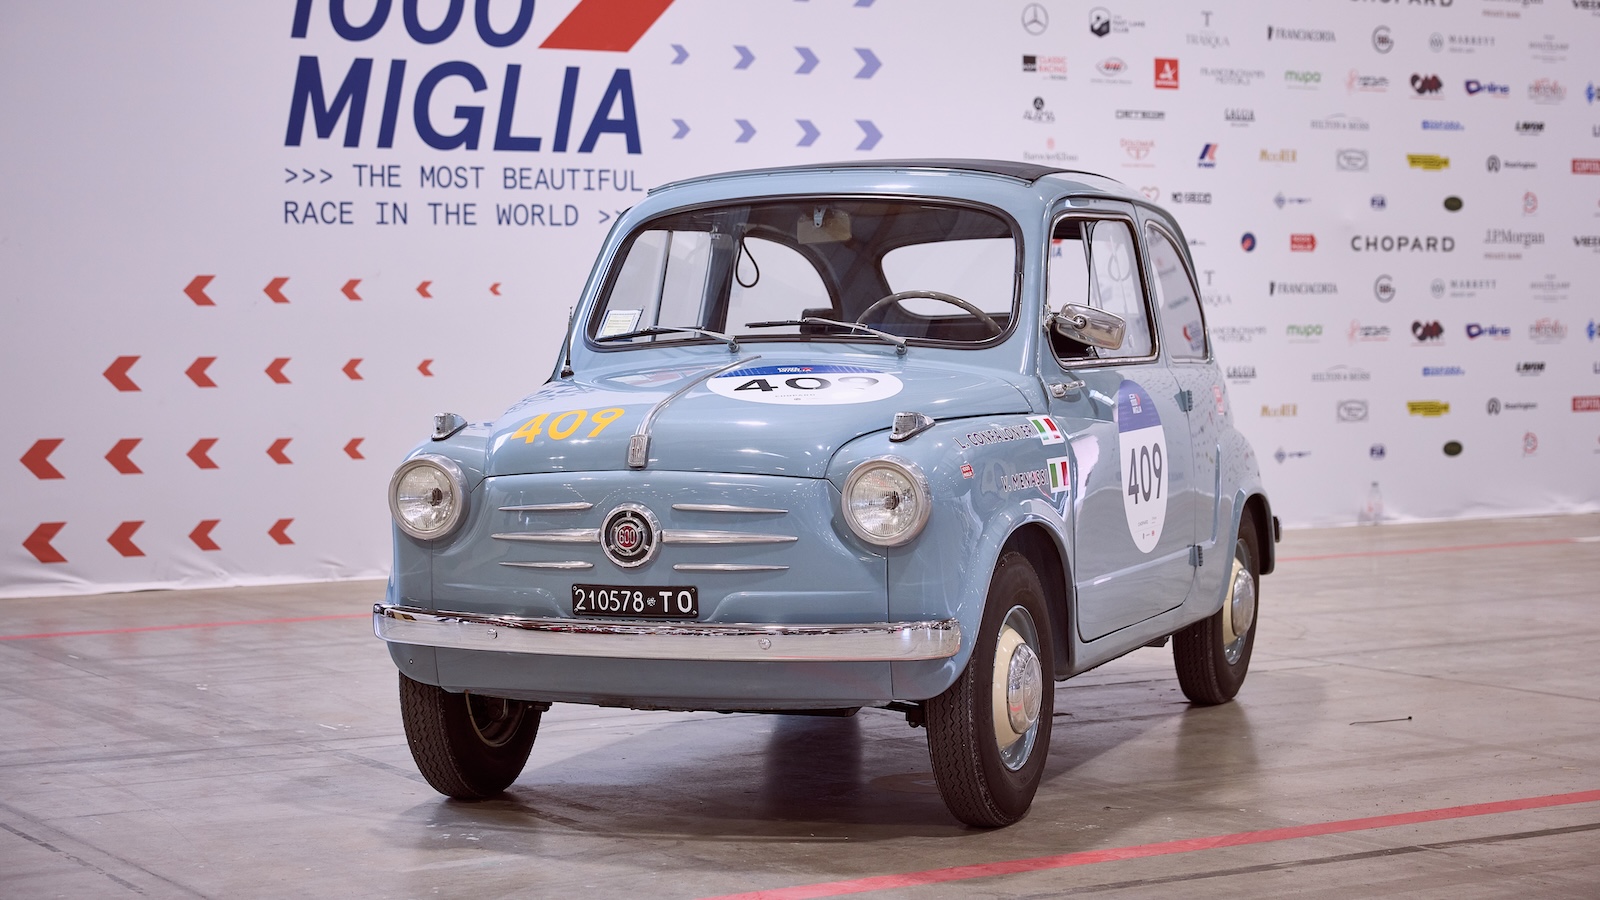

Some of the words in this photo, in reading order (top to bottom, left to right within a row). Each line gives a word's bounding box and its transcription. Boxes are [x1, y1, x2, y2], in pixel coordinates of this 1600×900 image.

[284, 55, 642, 154] MIGLIA
[353, 164, 402, 188] THE
[420, 166, 485, 190] MOST
[503, 167, 643, 192] BEAUTIFUL
[284, 201, 354, 225] RACE
[375, 202, 408, 226] IN
[428, 203, 477, 226] THE
[497, 204, 579, 227] WORLD
[1351, 235, 1455, 252] CHOPARD
[510, 407, 625, 444] 409
[953, 437, 970, 450] L.
[1001, 475, 1012, 492] V.
[1128, 442, 1163, 504] 409
[618, 529, 636, 544] 600
[575, 588, 645, 612] 210578
